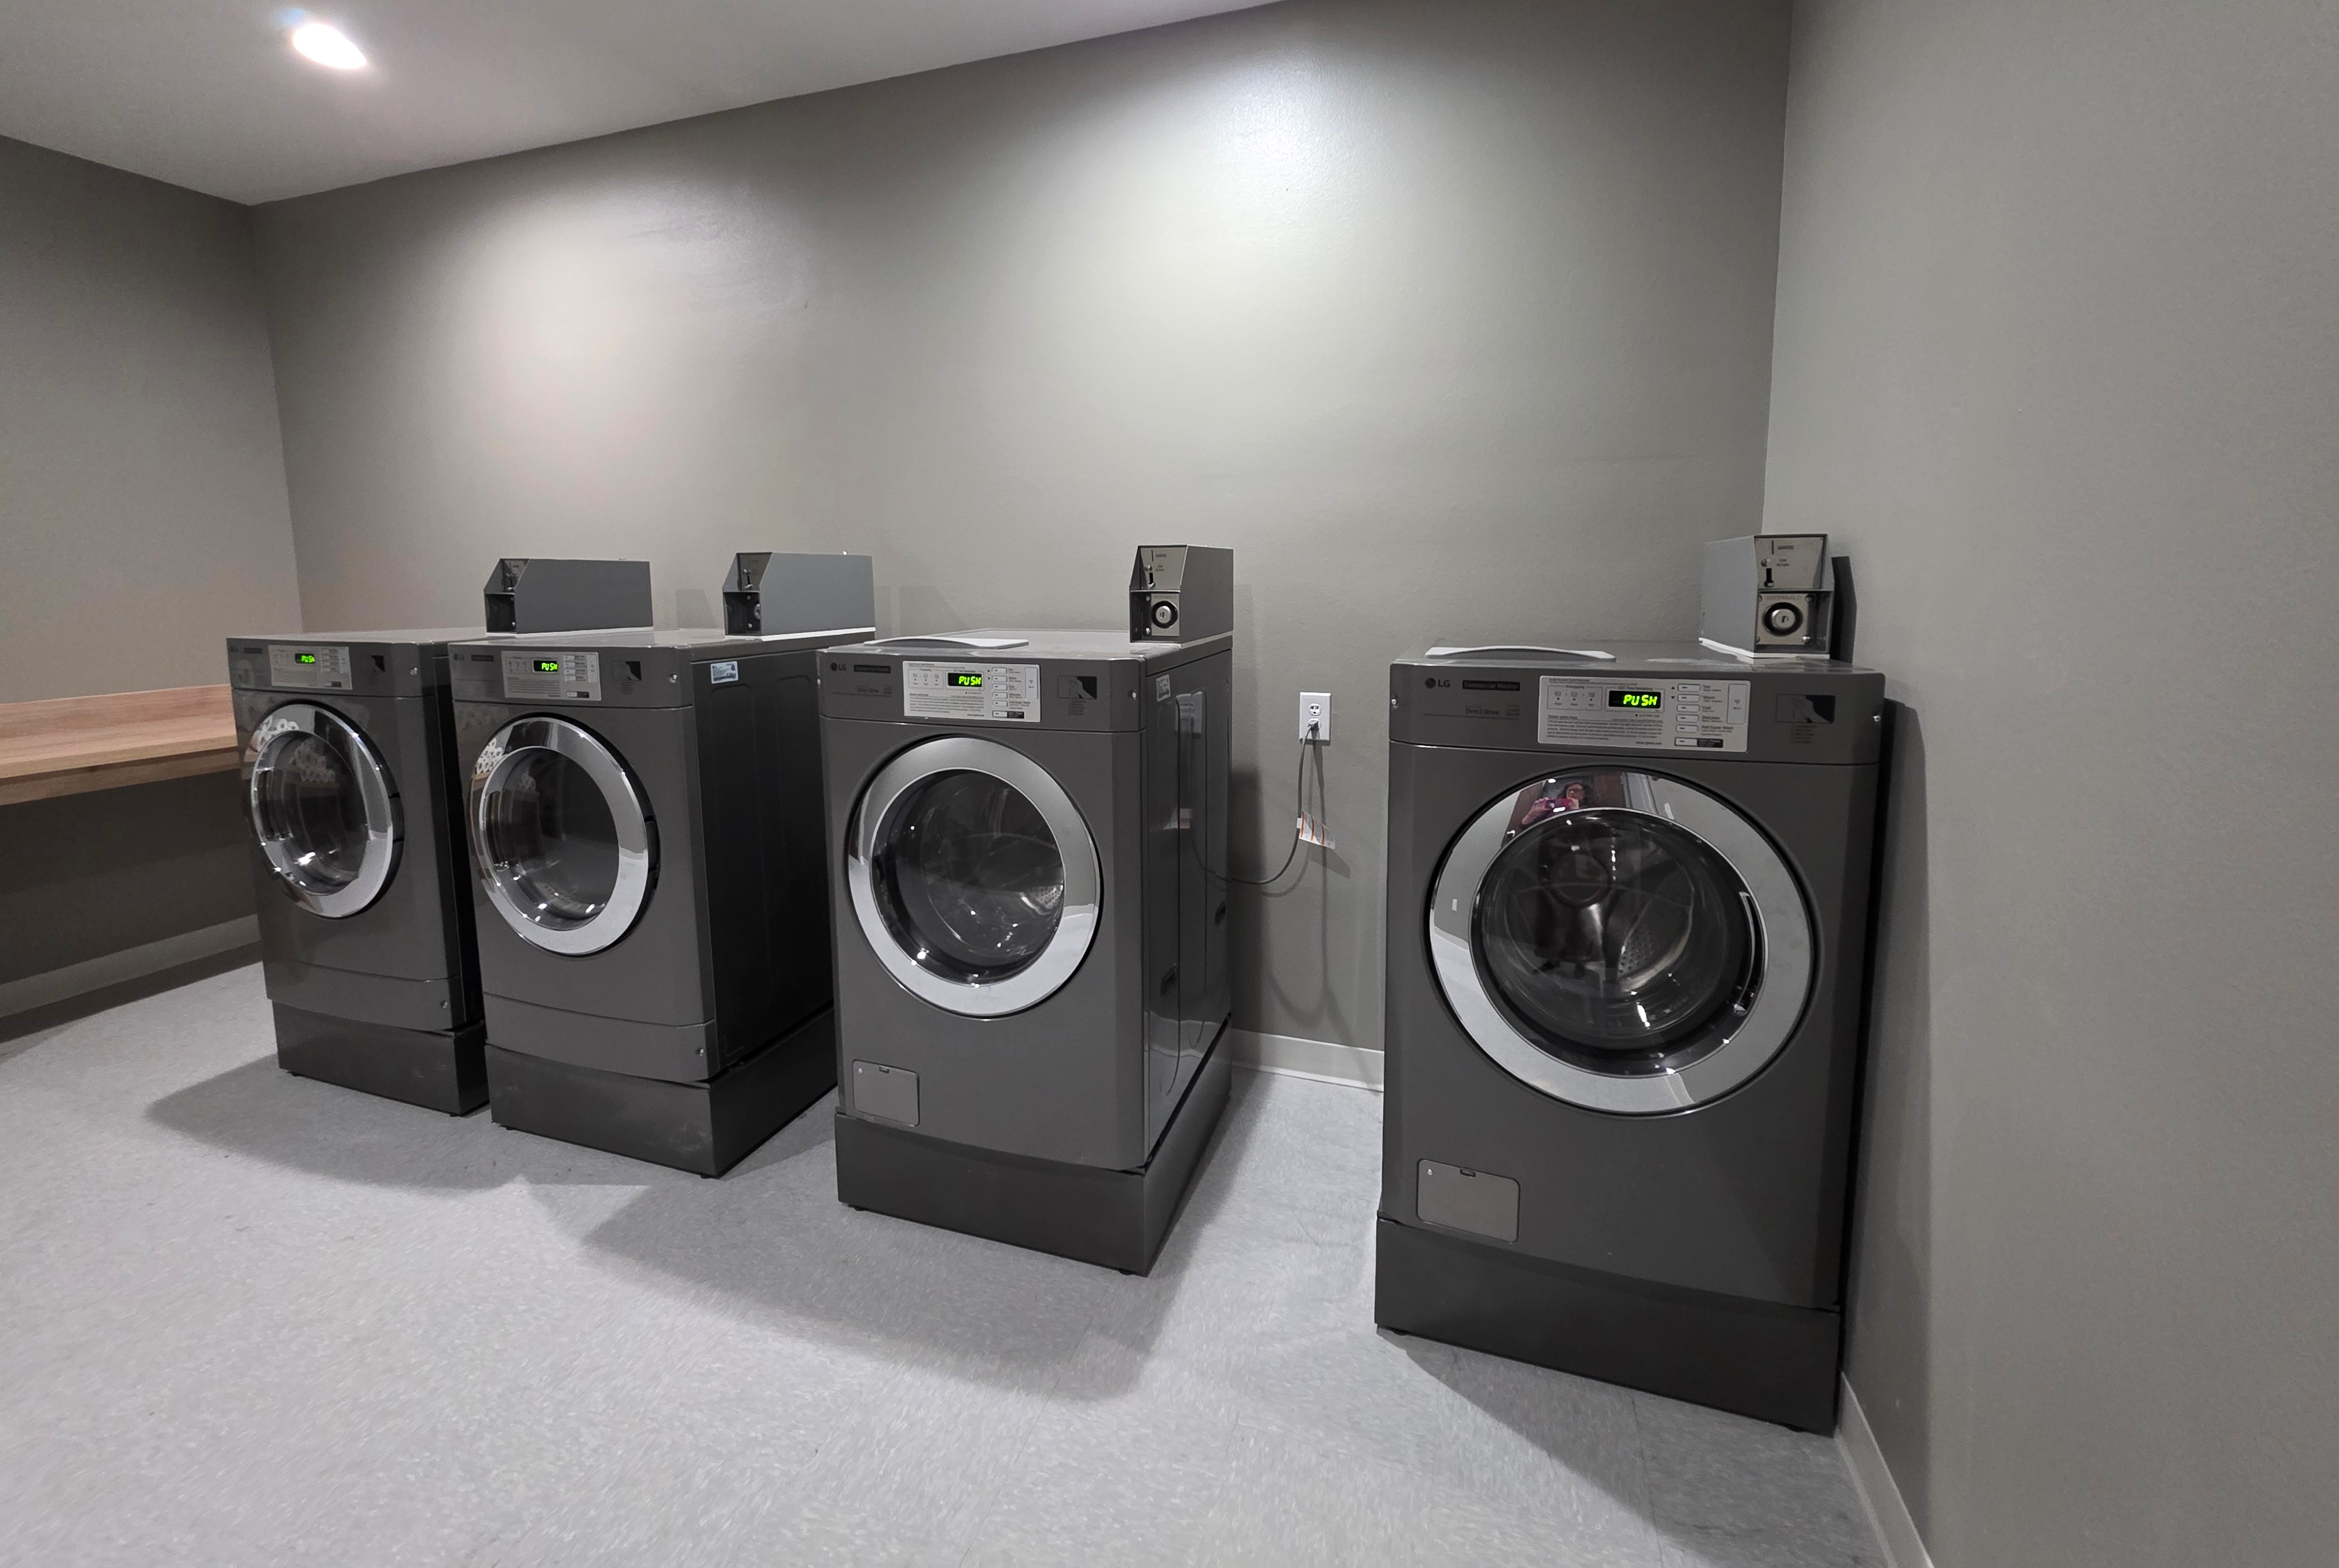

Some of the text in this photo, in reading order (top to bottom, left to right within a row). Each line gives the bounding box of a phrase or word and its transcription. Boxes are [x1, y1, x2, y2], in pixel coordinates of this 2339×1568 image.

[958, 676, 982, 685] PUSH
[1438, 679, 1450, 688] LG
[1623, 694, 1658, 706] PUSH
